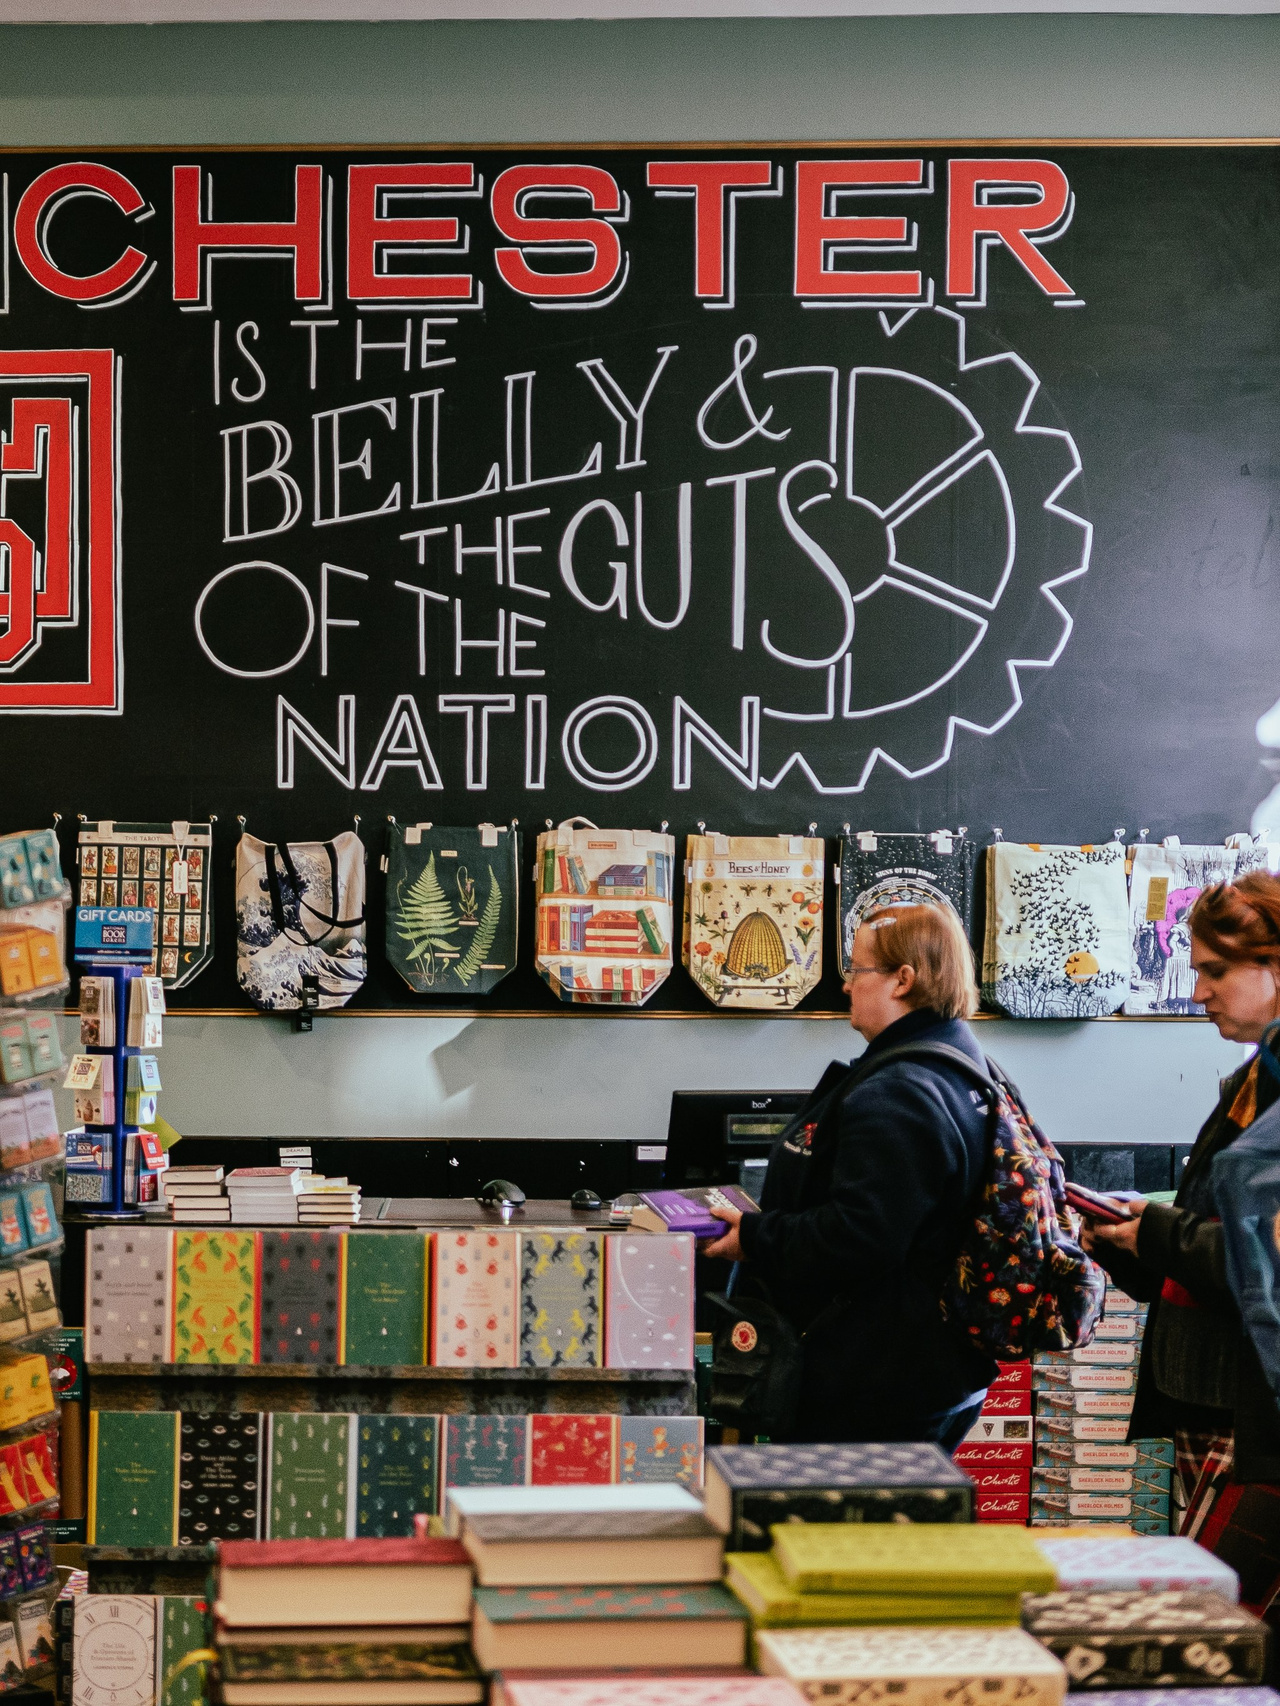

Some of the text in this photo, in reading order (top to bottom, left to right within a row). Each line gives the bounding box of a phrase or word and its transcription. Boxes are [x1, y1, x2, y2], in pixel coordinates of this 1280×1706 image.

[213, 317, 459, 404] IS THE
[221, 334, 790, 542] BELLY &
[400, 458, 856, 668] THE GUTS
[194, 560, 546, 677] OF THE
[276, 694, 762, 791] NATION
[728, 862, 753, 874] BEES
[761, 862, 790, 873] HONEY
[875, 868, 894, 878] SIGNS
[78, 909, 152, 922] GIFT CARDS
[102, 930, 125, 938] BOOK
[752, 1100, 767, 1109] box
[982, 1397, 1022, 1410] Christie
[984, 1448, 1022, 1461] Christie
[981, 1473, 1021, 1487] Christie
[980, 1499, 1020, 1513] Christie
